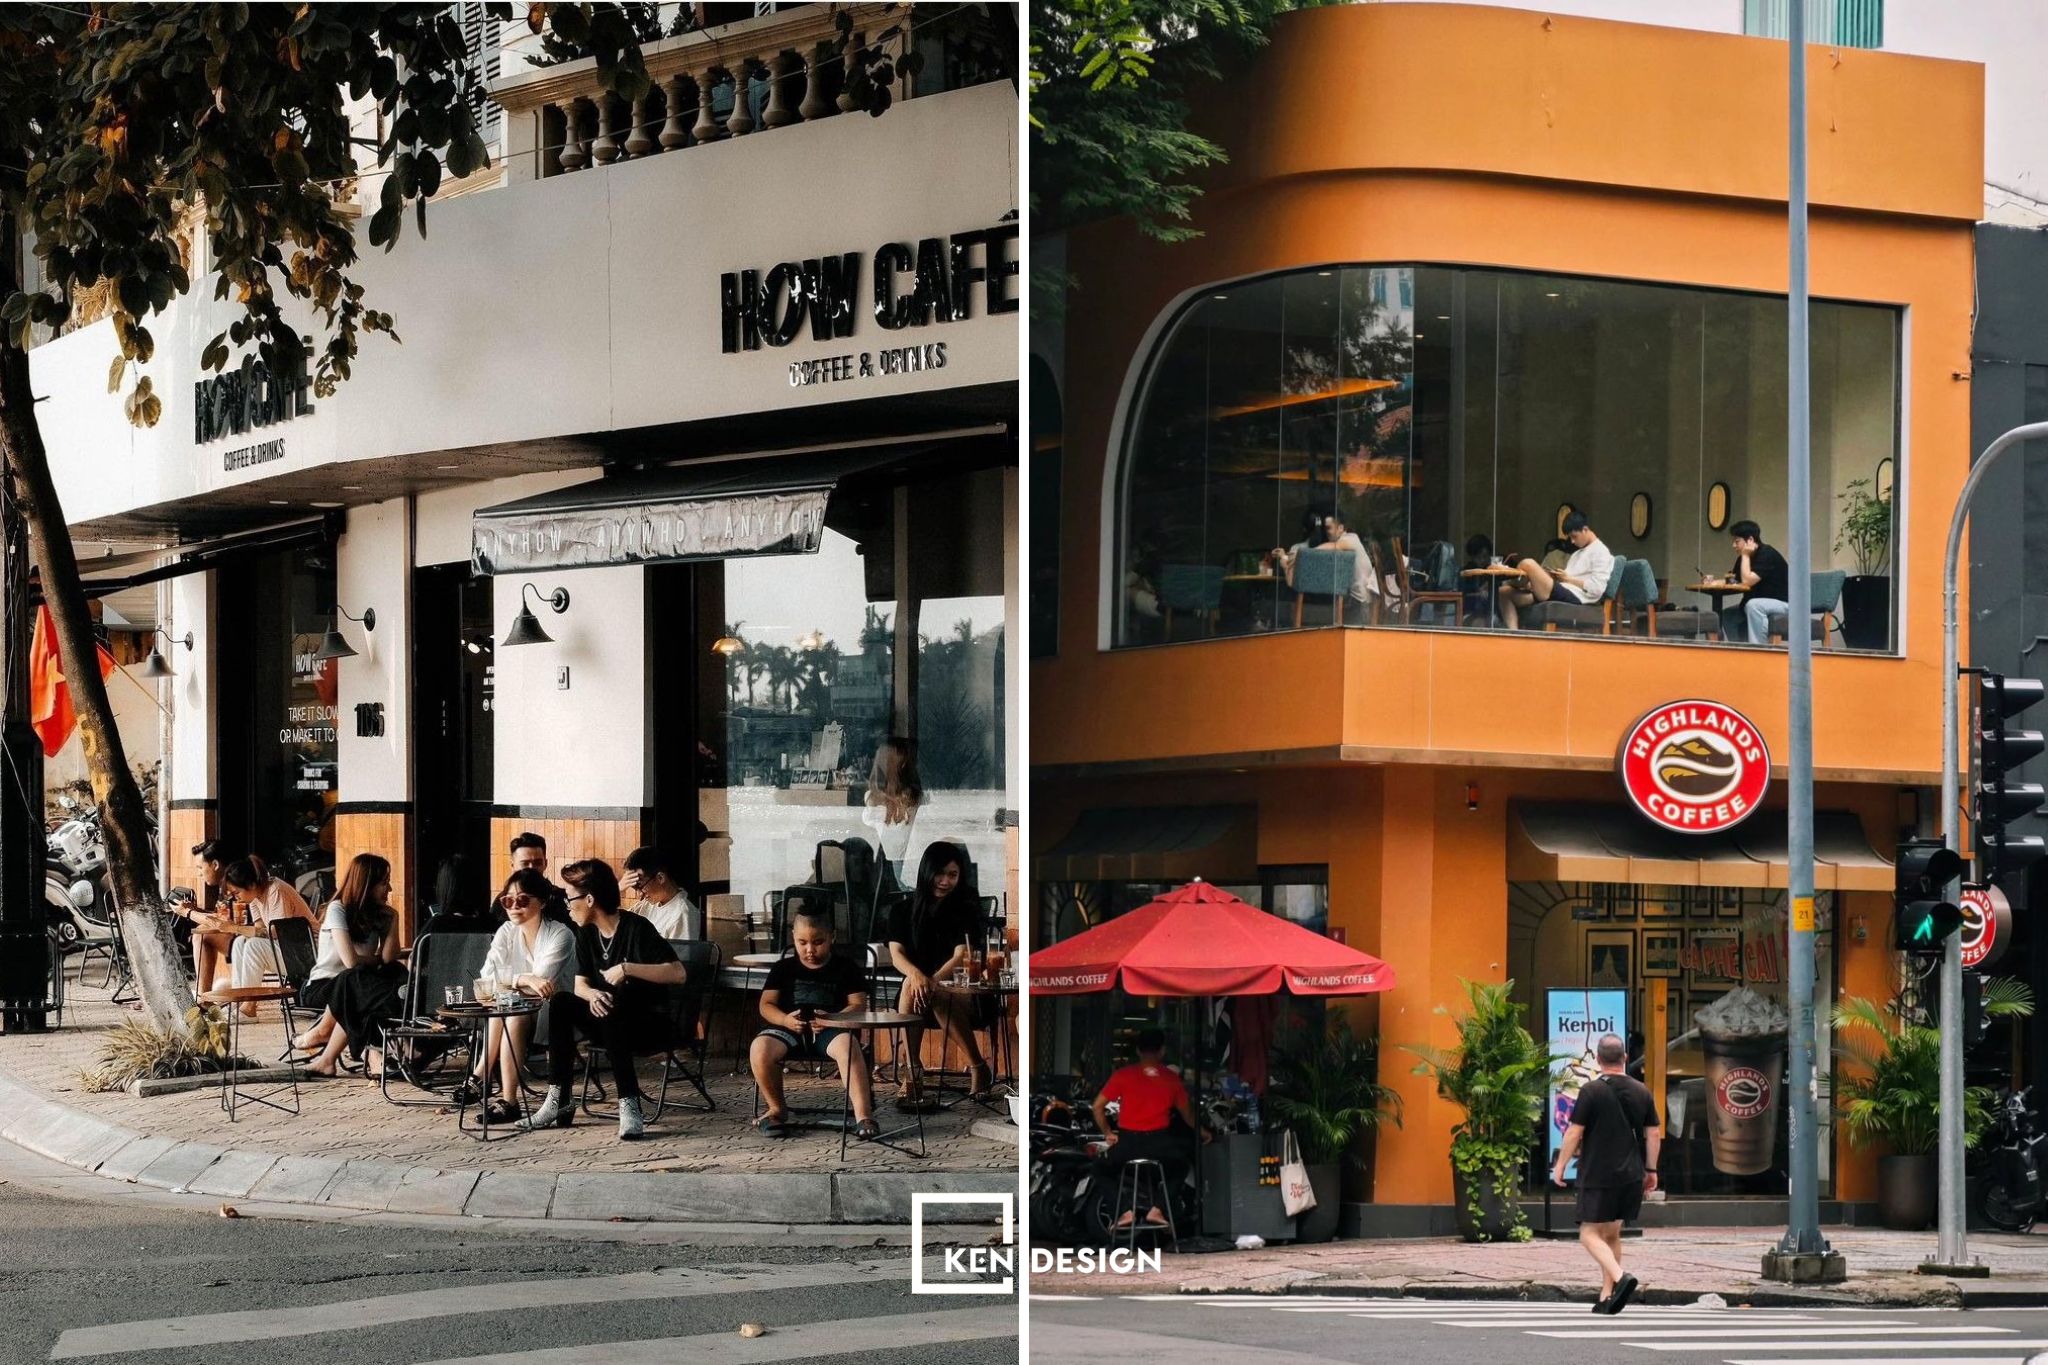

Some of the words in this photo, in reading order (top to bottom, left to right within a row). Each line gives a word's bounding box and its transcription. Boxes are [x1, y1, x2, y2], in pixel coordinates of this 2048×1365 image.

[720, 252, 861, 354] HOW
[788, 354, 855, 388] COFFEE
[859, 352, 875, 378] &
[879, 342, 947, 376] DRINKS
[195, 368, 252, 445] HOW
[224, 448, 250, 471] COFFEE
[250, 445, 257, 464] &
[257, 438, 285, 463] DRINKS
[481, 528, 562, 557] ANYHOW
[596, 518, 686, 548] ANYWHO
[724, 508, 823, 540] ANYHOW
[288, 706, 306, 721] TAKE
[307, 706, 315, 721] IT
[280, 728, 291, 744] OR
[292, 728, 312, 743] MAKE
[313, 728, 322, 743] IT
[323, 727, 335, 742] TO
[1632, 708, 1761, 763] HIGHLANDS
[1647, 793, 1747, 825] COFFEE
[1799, 910, 1809, 920] 21
[1343, 973, 1375, 985] COFFEE
[1558, 1015, 1614, 1033] KemDi
[1720, 1070, 1768, 1092] HIGHLANDS
[1724, 1103, 1763, 1116] COFFEE
